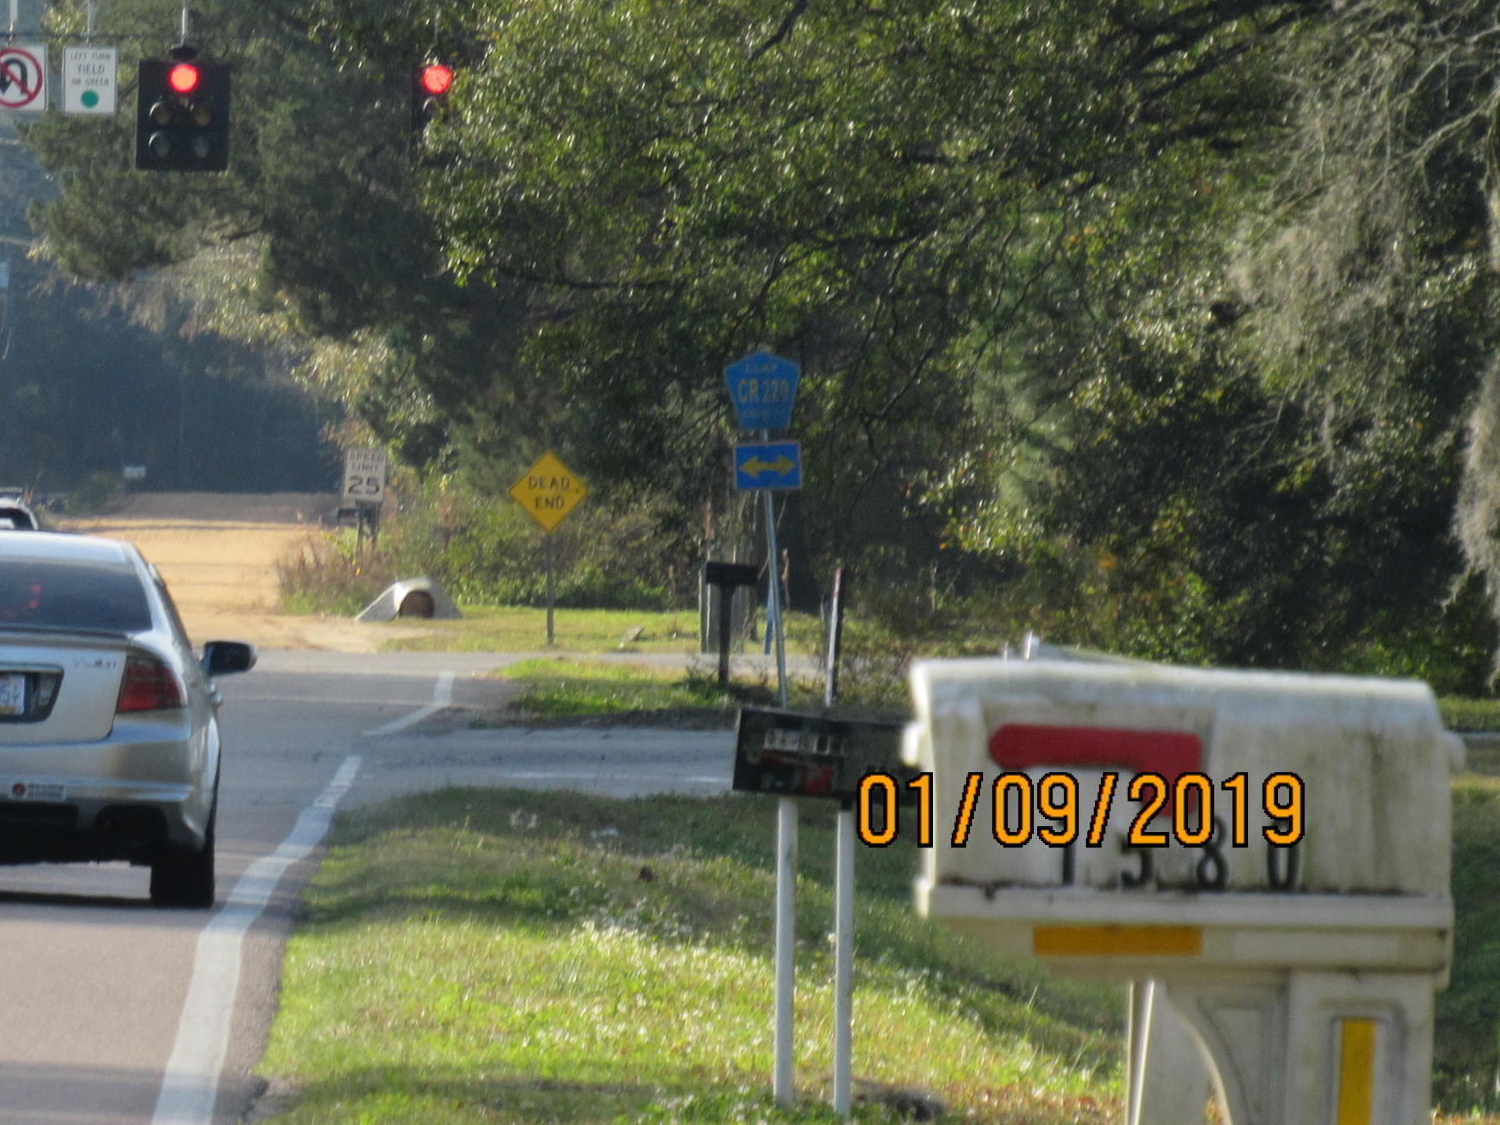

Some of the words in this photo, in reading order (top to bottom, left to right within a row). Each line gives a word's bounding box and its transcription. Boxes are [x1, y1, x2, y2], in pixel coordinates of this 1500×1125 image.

[77, 64, 105, 75] YIELD
[739, 379, 758, 403] CR
[763, 379, 789, 403] 220
[348, 475, 380, 495] 25
[528, 475, 570, 491] DEAD
[535, 495, 565, 509] END
